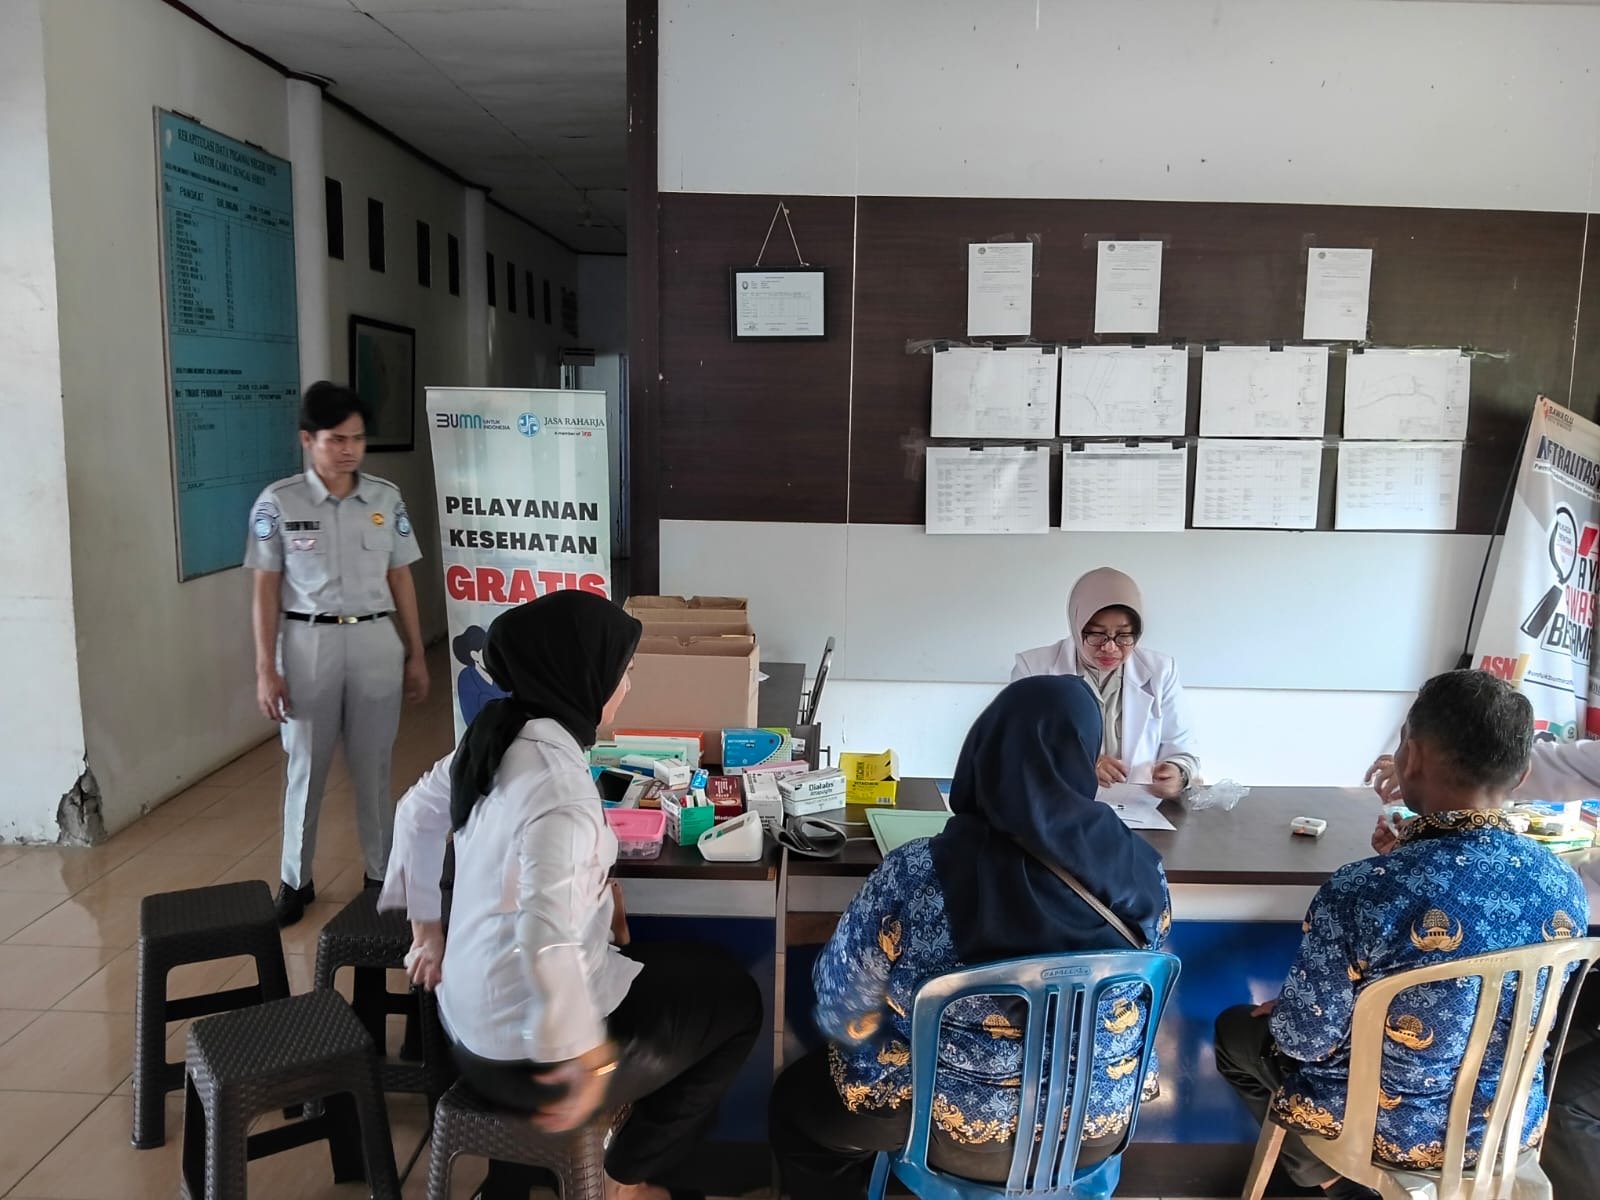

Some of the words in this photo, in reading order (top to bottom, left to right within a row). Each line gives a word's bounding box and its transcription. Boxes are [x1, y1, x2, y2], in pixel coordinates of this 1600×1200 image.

[544, 417, 563, 426] JASA
[565, 418, 605, 428] RAHARJA
[1549, 406, 1574, 425] BAWASLU
[445, 496, 598, 521] PELAYANAN
[449, 529, 598, 554] KESEHATAN
[1479, 655, 1518, 680] ASN
